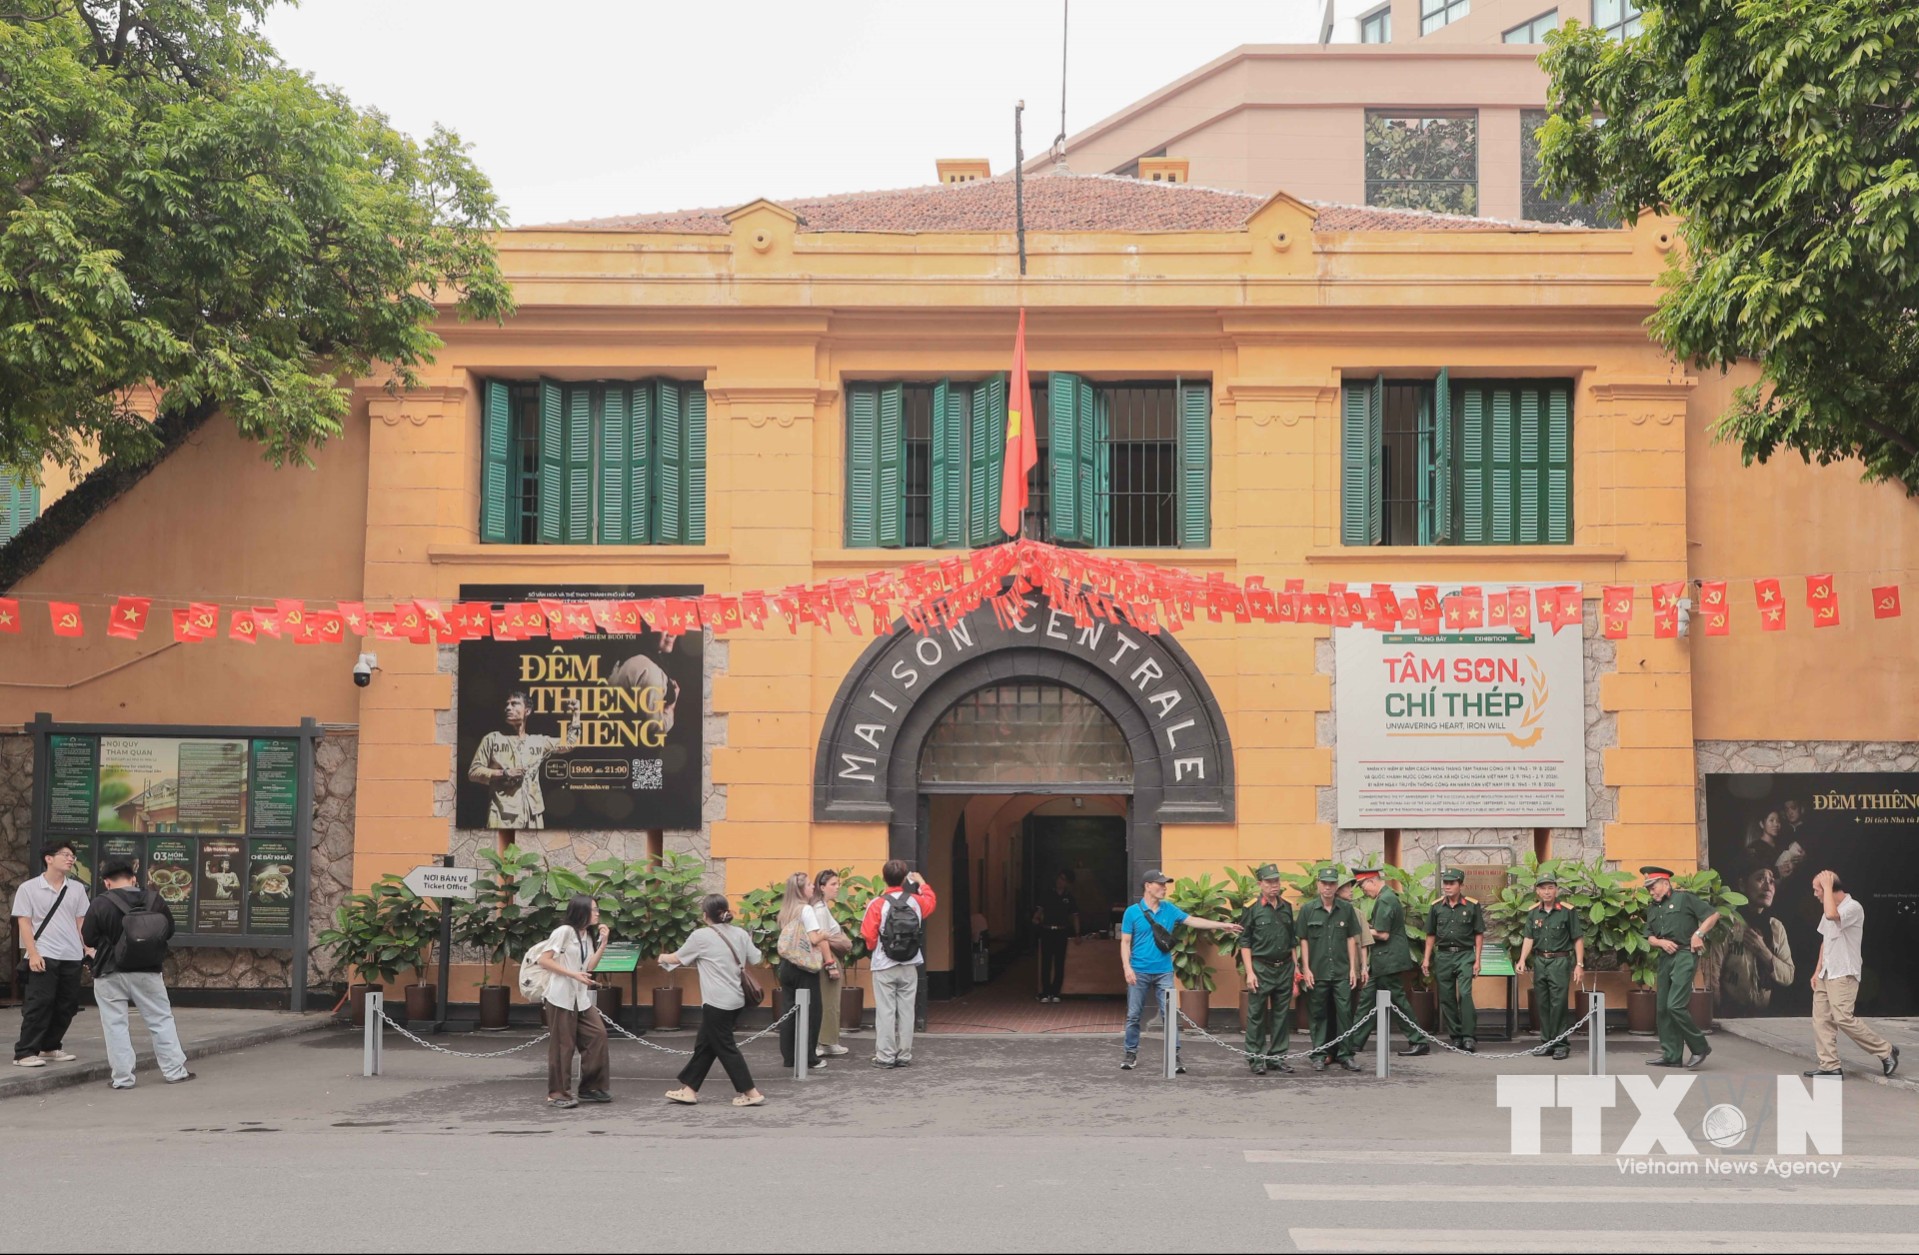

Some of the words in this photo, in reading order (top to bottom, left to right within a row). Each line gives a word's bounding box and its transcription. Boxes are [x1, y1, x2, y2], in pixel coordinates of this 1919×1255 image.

[519, 645, 602, 682] ĐÊM
[1383, 651, 1445, 683] TÂM
[529, 677, 667, 714] THIÊNG
[838, 617, 974, 783] MAISON
[1013, 600, 1205, 782] CENTRALE
[1385, 686, 1437, 717] CHÍ
[1442, 686, 1523, 717] THÉP
[557, 712, 668, 748] LIÊNG
[1440, 722, 1465, 731] HEART,
[1813, 790, 1857, 810] ĐÊM
[153, 852, 167, 861] 03
